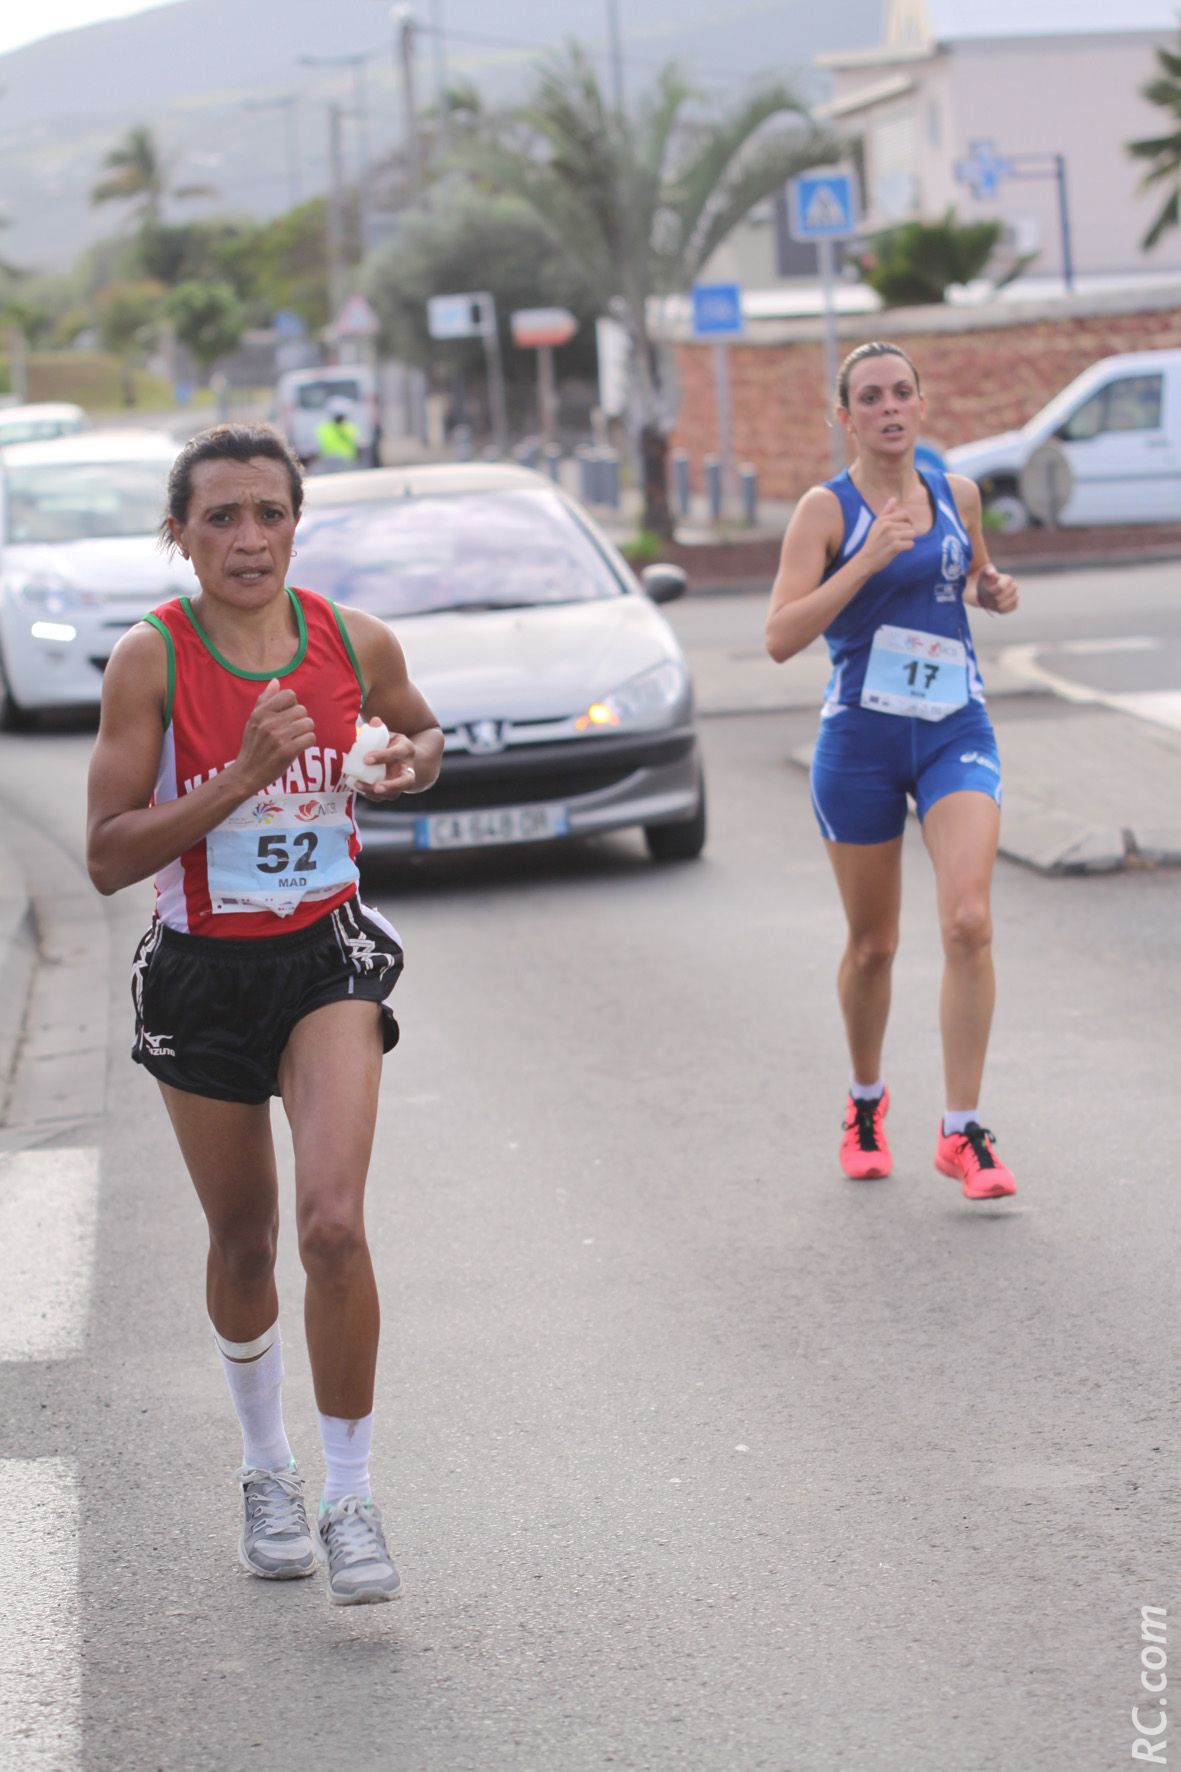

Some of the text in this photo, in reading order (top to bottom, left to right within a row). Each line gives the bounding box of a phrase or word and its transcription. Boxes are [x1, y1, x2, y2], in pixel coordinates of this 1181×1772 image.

[903, 660, 940, 690] 17
[256, 831, 319, 874] 52
[278, 877, 307, 888] MAD
